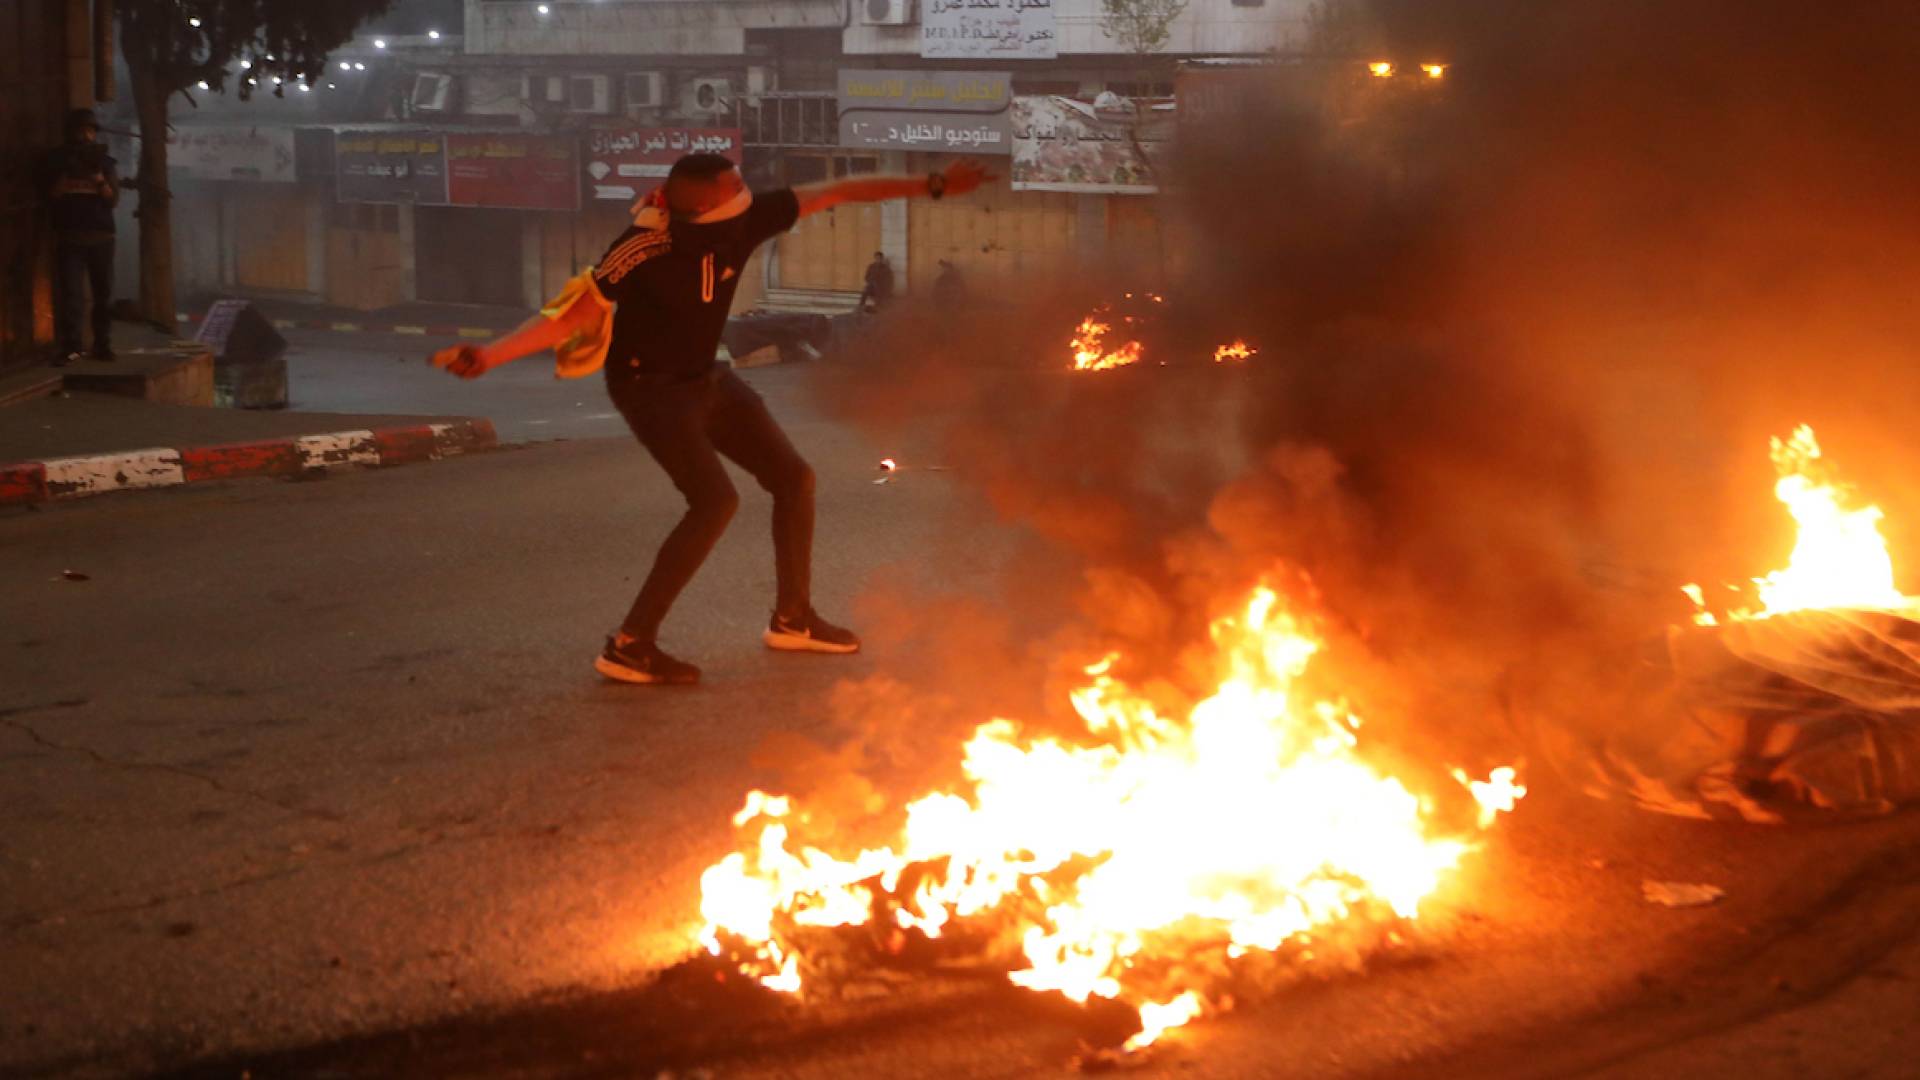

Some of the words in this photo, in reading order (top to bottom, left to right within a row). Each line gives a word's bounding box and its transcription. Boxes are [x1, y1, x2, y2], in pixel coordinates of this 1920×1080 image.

[642, 131, 666, 154] نمر
[671, 131, 732, 154] مجوهرات
[901, 123, 942, 143] الخليل
[945, 125, 1000, 146] ستوديو
